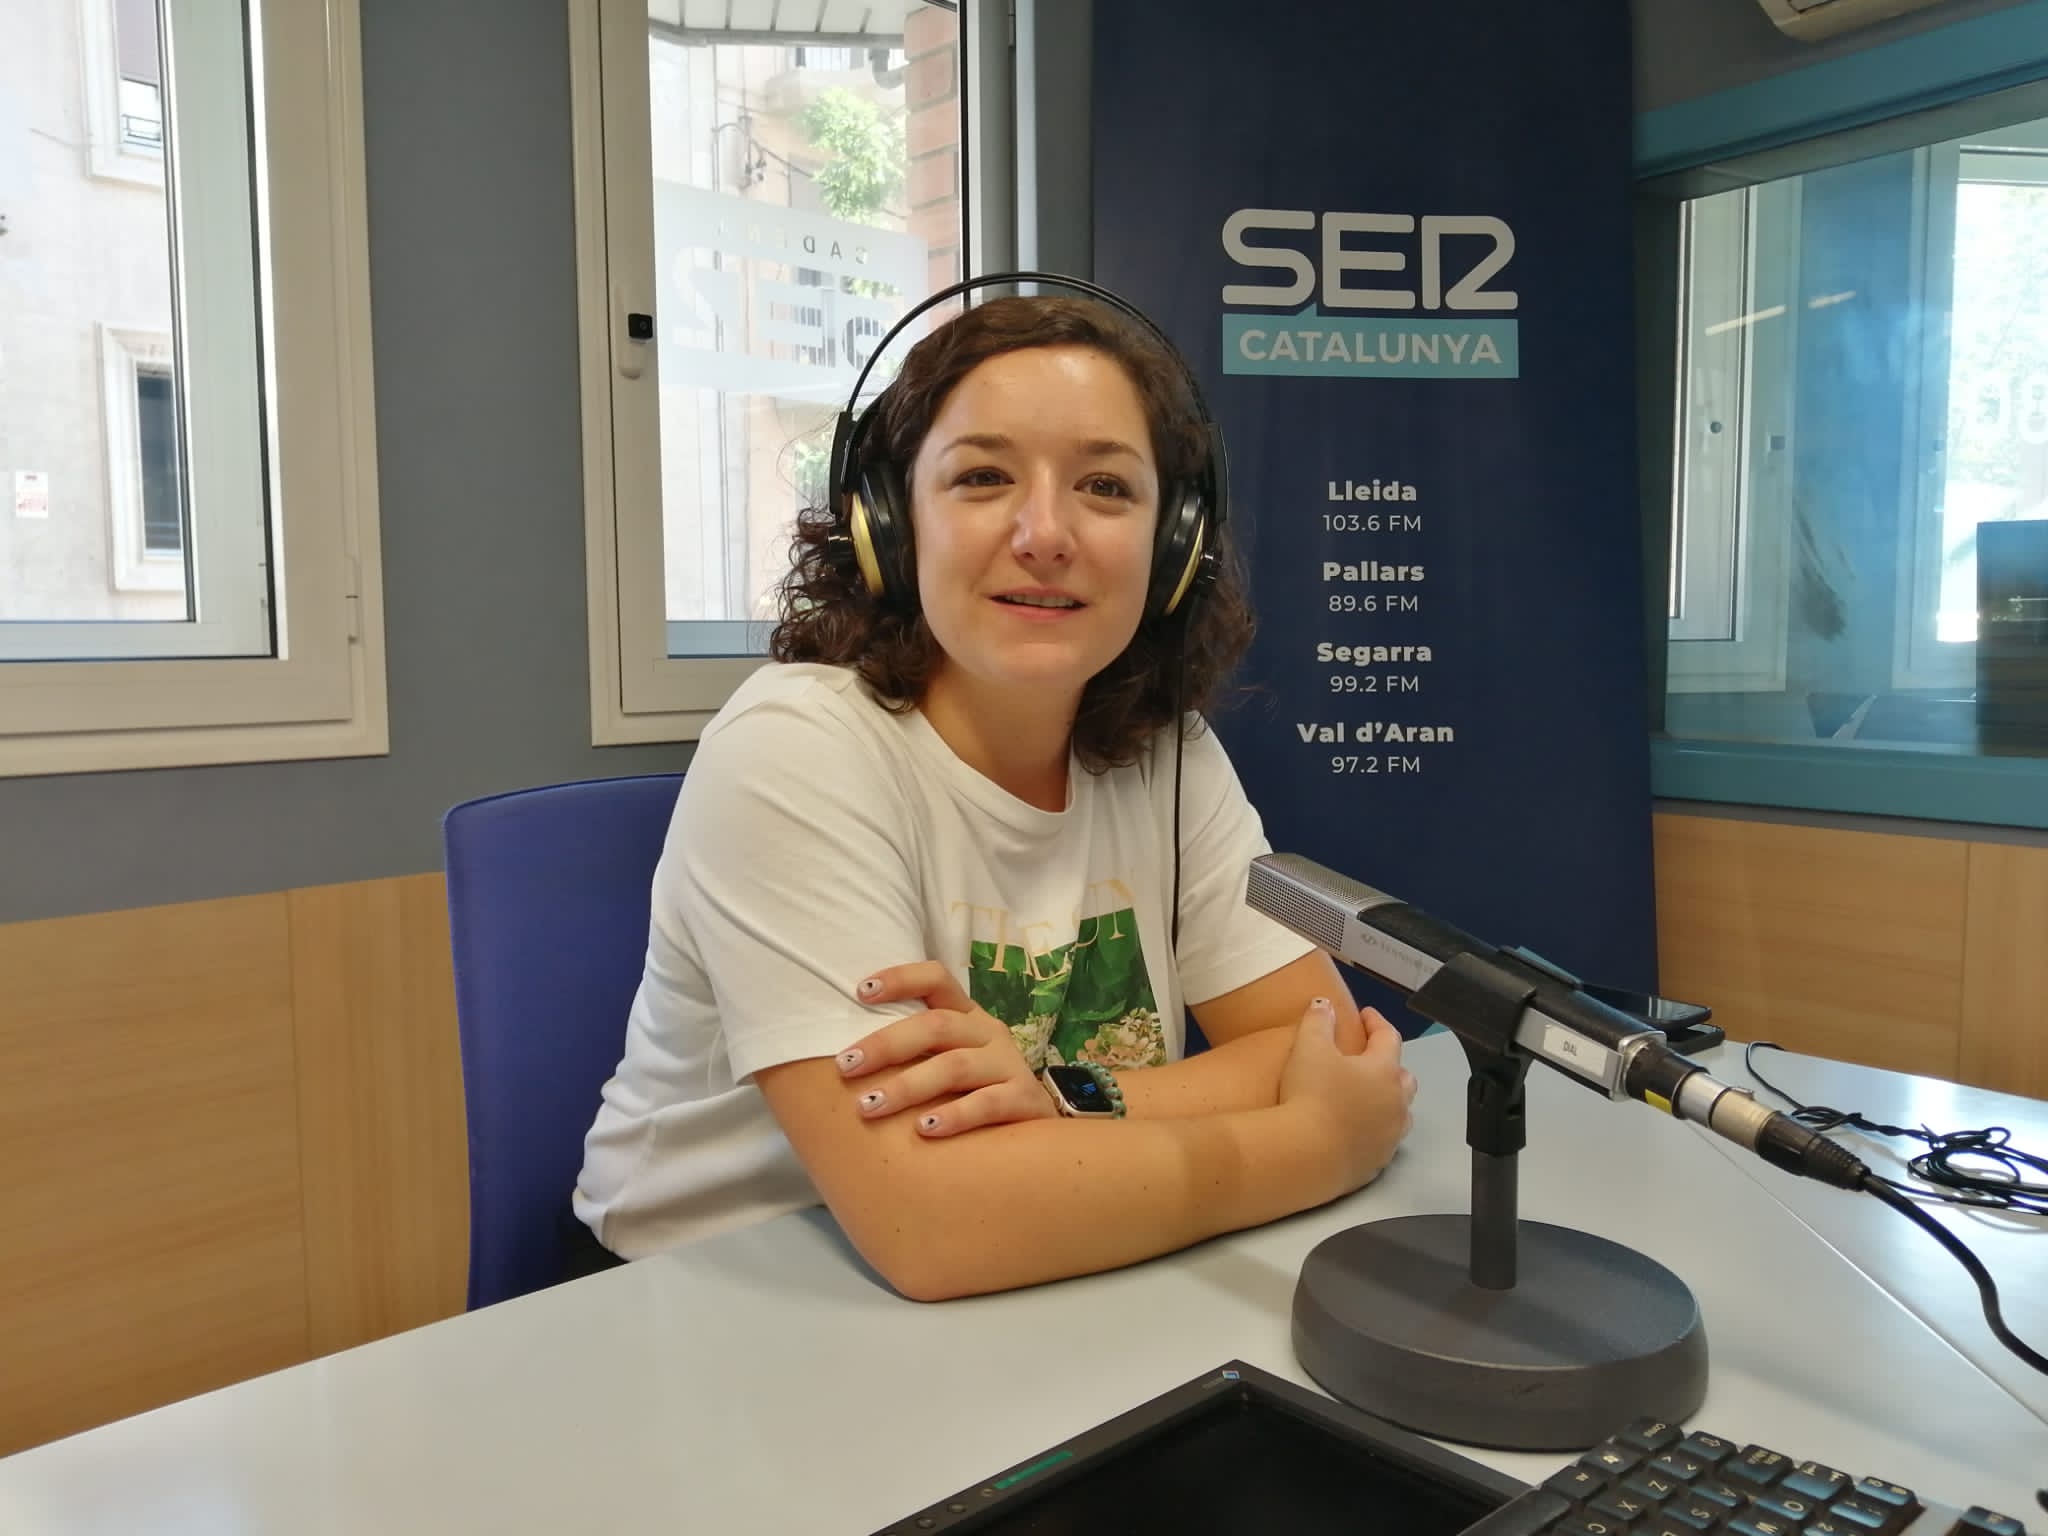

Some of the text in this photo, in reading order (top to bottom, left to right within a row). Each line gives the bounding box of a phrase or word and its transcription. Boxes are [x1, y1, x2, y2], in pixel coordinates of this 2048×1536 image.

[1222, 208, 1518, 310] SER
[1239, 329, 1502, 364] CATALUNYA
[1328, 479, 1417, 501] Lleida
[1322, 515, 1422, 531] 103.6 FM
[1323, 561, 1425, 581] Pallars
[1328, 595, 1418, 612] 89.6 FM
[1317, 642, 1432, 667] Segarra
[1330, 676, 1419, 693] 99.2 FM
[1297, 722, 1454, 743] Val d’Aran
[1331, 756, 1420, 774] 97.2 FM
